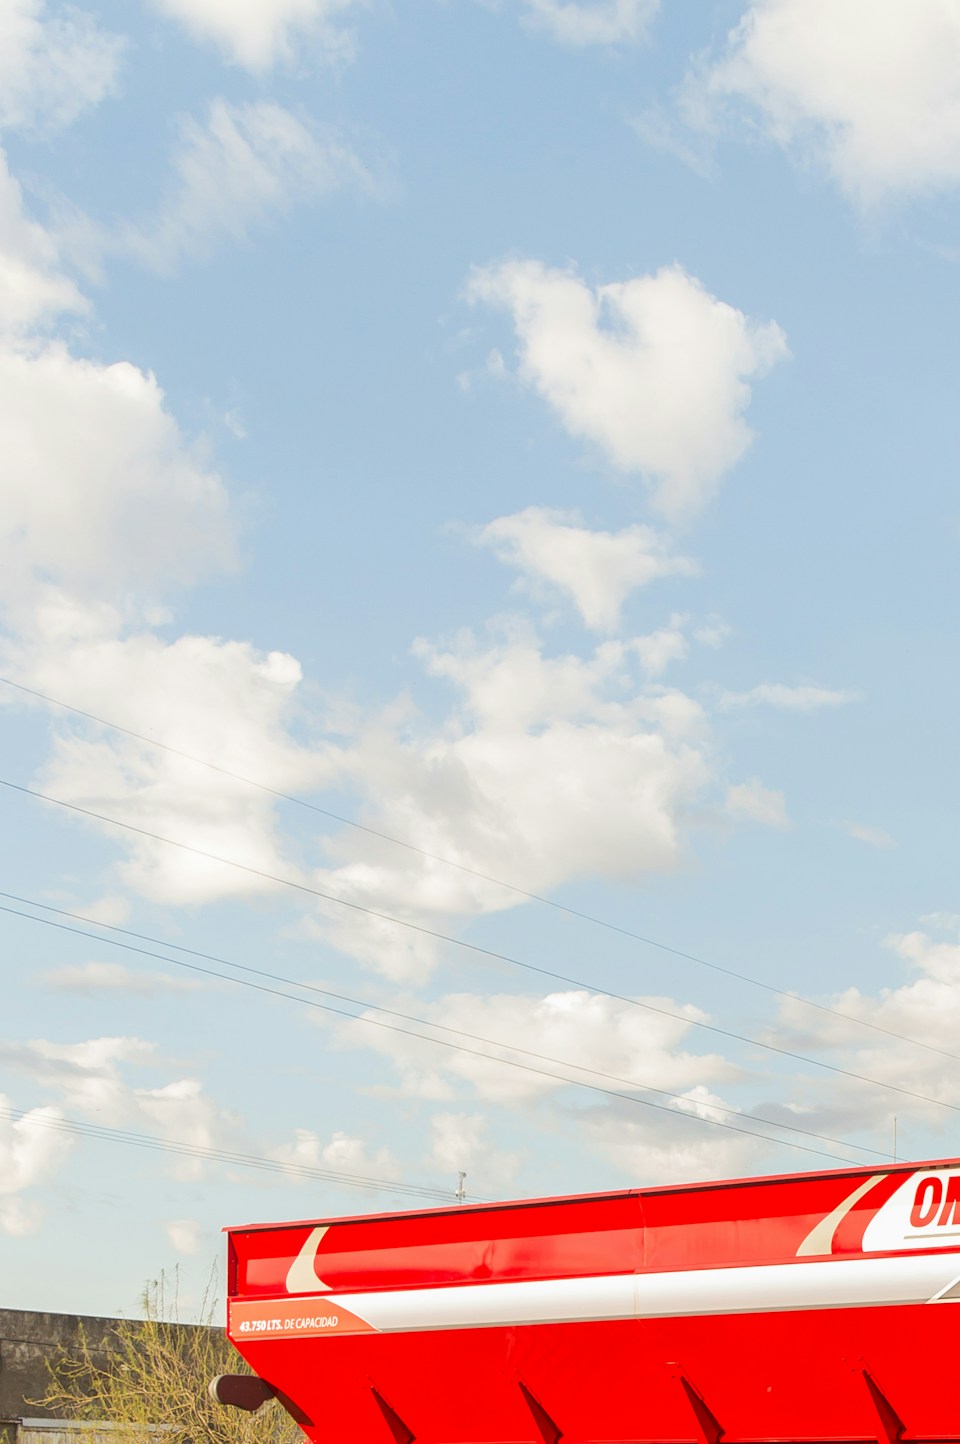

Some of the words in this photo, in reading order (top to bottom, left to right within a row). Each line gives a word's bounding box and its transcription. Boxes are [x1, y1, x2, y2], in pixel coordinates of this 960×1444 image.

[239, 1320, 266, 1332] 43.750
[267, 1319, 283, 1331] LTS.
[284, 1318, 294, 1329] DE
[295, 1316, 338, 1329] CAPACIDAD
